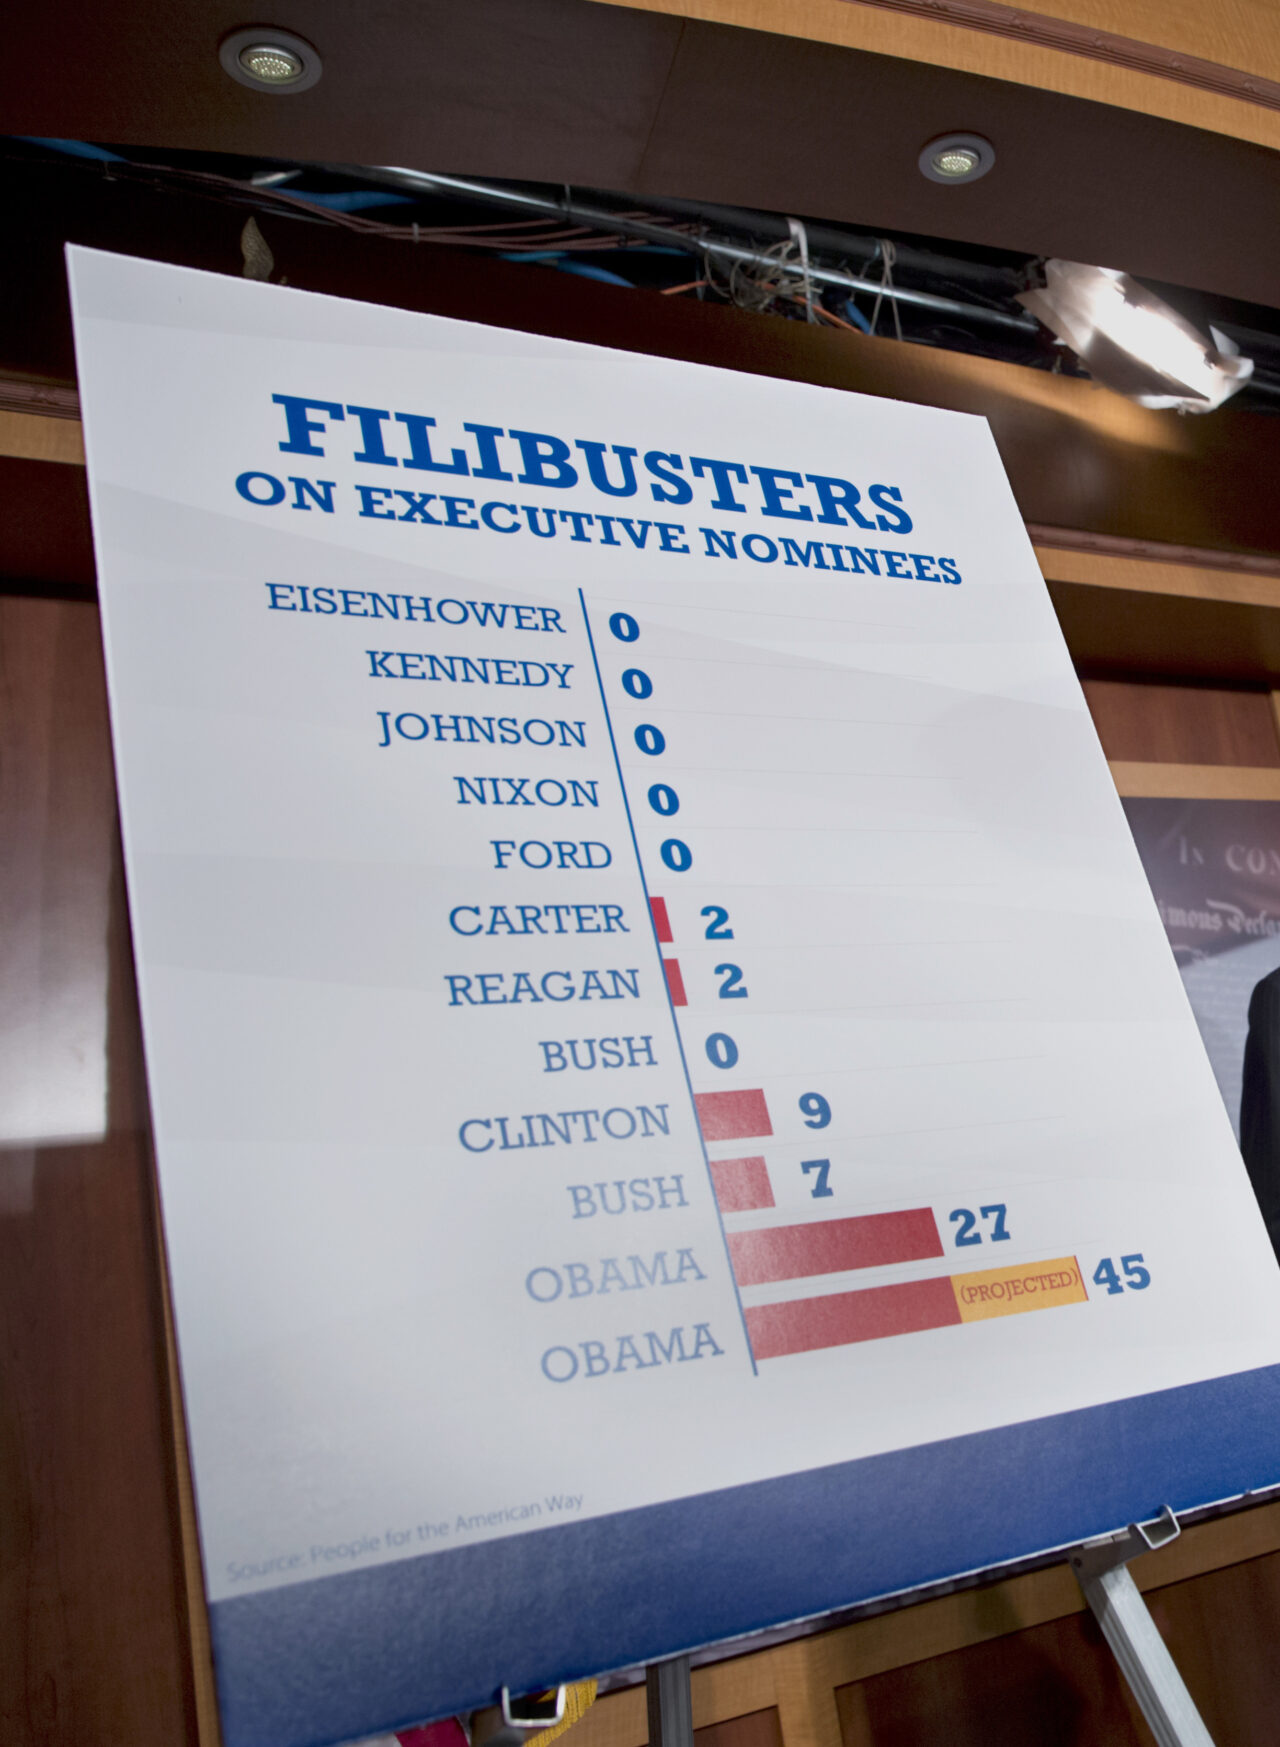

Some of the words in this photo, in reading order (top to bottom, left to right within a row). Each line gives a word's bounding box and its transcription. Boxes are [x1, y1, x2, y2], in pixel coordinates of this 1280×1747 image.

[271, 393, 913, 535] FILIBUSTERS
[235, 471, 337, 513] ON
[354, 484, 691, 554] EXECUTIVE
[698, 527, 962, 585] NOMINEES
[265, 582, 567, 633] EISENHOWER
[608, 612, 640, 643] 0
[365, 650, 574, 689] KENNEDY
[621, 668, 653, 700] 0
[376, 711, 586, 748] JOHNSON
[633, 723, 666, 756] 0
[453, 776, 599, 808] NIXON
[647, 783, 680, 817] 0
[489, 840, 612, 869] FORD
[660, 838, 693, 873] 0
[448, 904, 630, 936] CARTER
[700, 905, 734, 940] 2
[443, 968, 640, 1007] REAGAN
[714, 963, 748, 999] 2
[538, 1035, 658, 1073] BUSH
[704, 1032, 739, 1070] 0
[458, 1103, 670, 1153] CLINTON
[798, 1092, 832, 1130] 9
[566, 1174, 689, 1220] BUSH
[800, 1158, 834, 1199] 7
[524, 1247, 708, 1304] OBAMA
[948, 1203, 1011, 1248] 27
[540, 1322, 726, 1384] OBAMA
[960, 1267, 1079, 1305] (PROJECTED)
[1092, 1253, 1151, 1295] 45
[225, 1554, 308, 1583] Source:
[309, 1536, 382, 1564] People
[384, 1528, 412, 1548] for
[416, 1521, 450, 1543] the
[455, 1501, 543, 1533] American
[544, 1492, 585, 1515] Way
